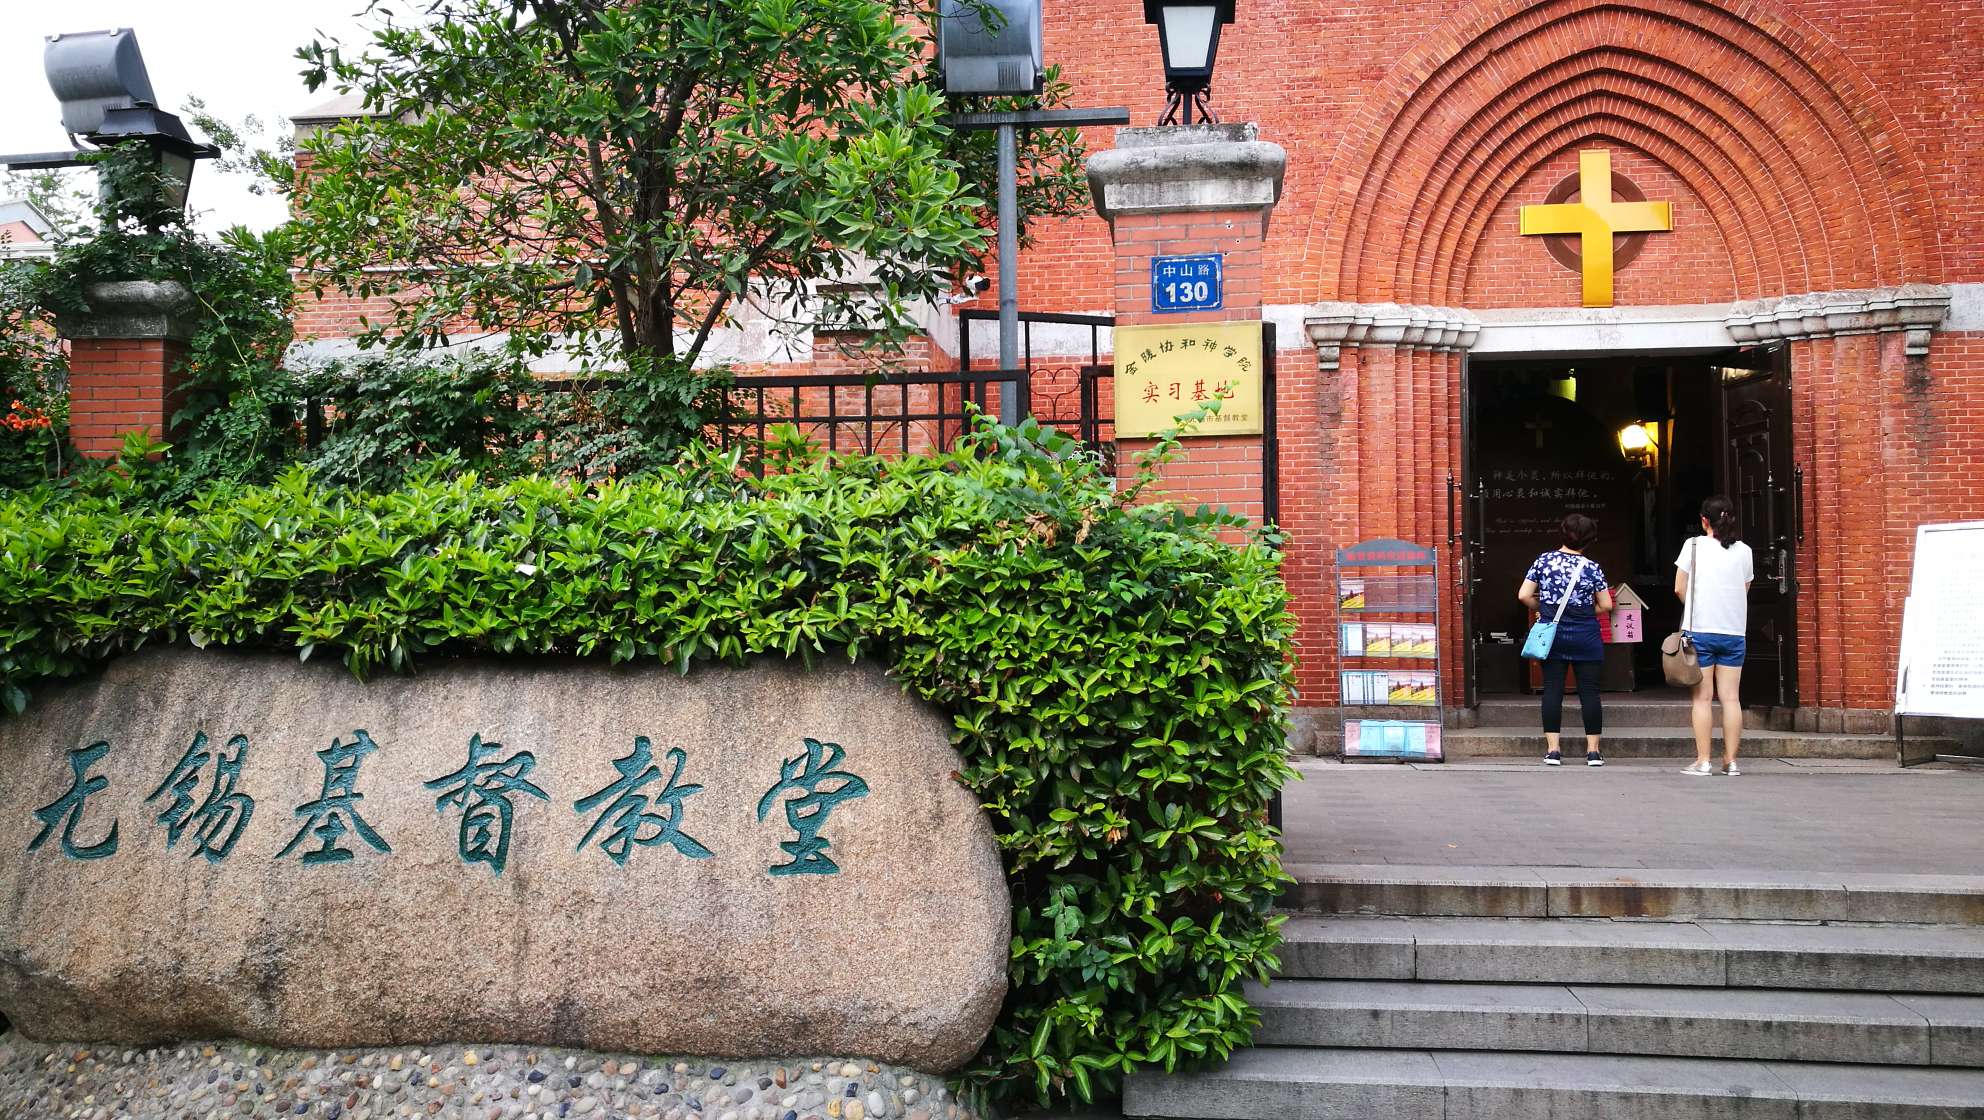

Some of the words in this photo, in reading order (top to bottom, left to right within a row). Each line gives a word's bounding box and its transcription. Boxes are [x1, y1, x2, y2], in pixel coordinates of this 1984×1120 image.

[1162, 263, 1210, 278] 中山路
[1165, 281, 1209, 303] 130
[1124, 338, 1252, 376] 金陵协和神学院
[1141, 379, 1235, 404] 实习基地
[1624, 613, 1636, 639] 建议箱
[26, 729, 870, 877] 无锡基督教堂
